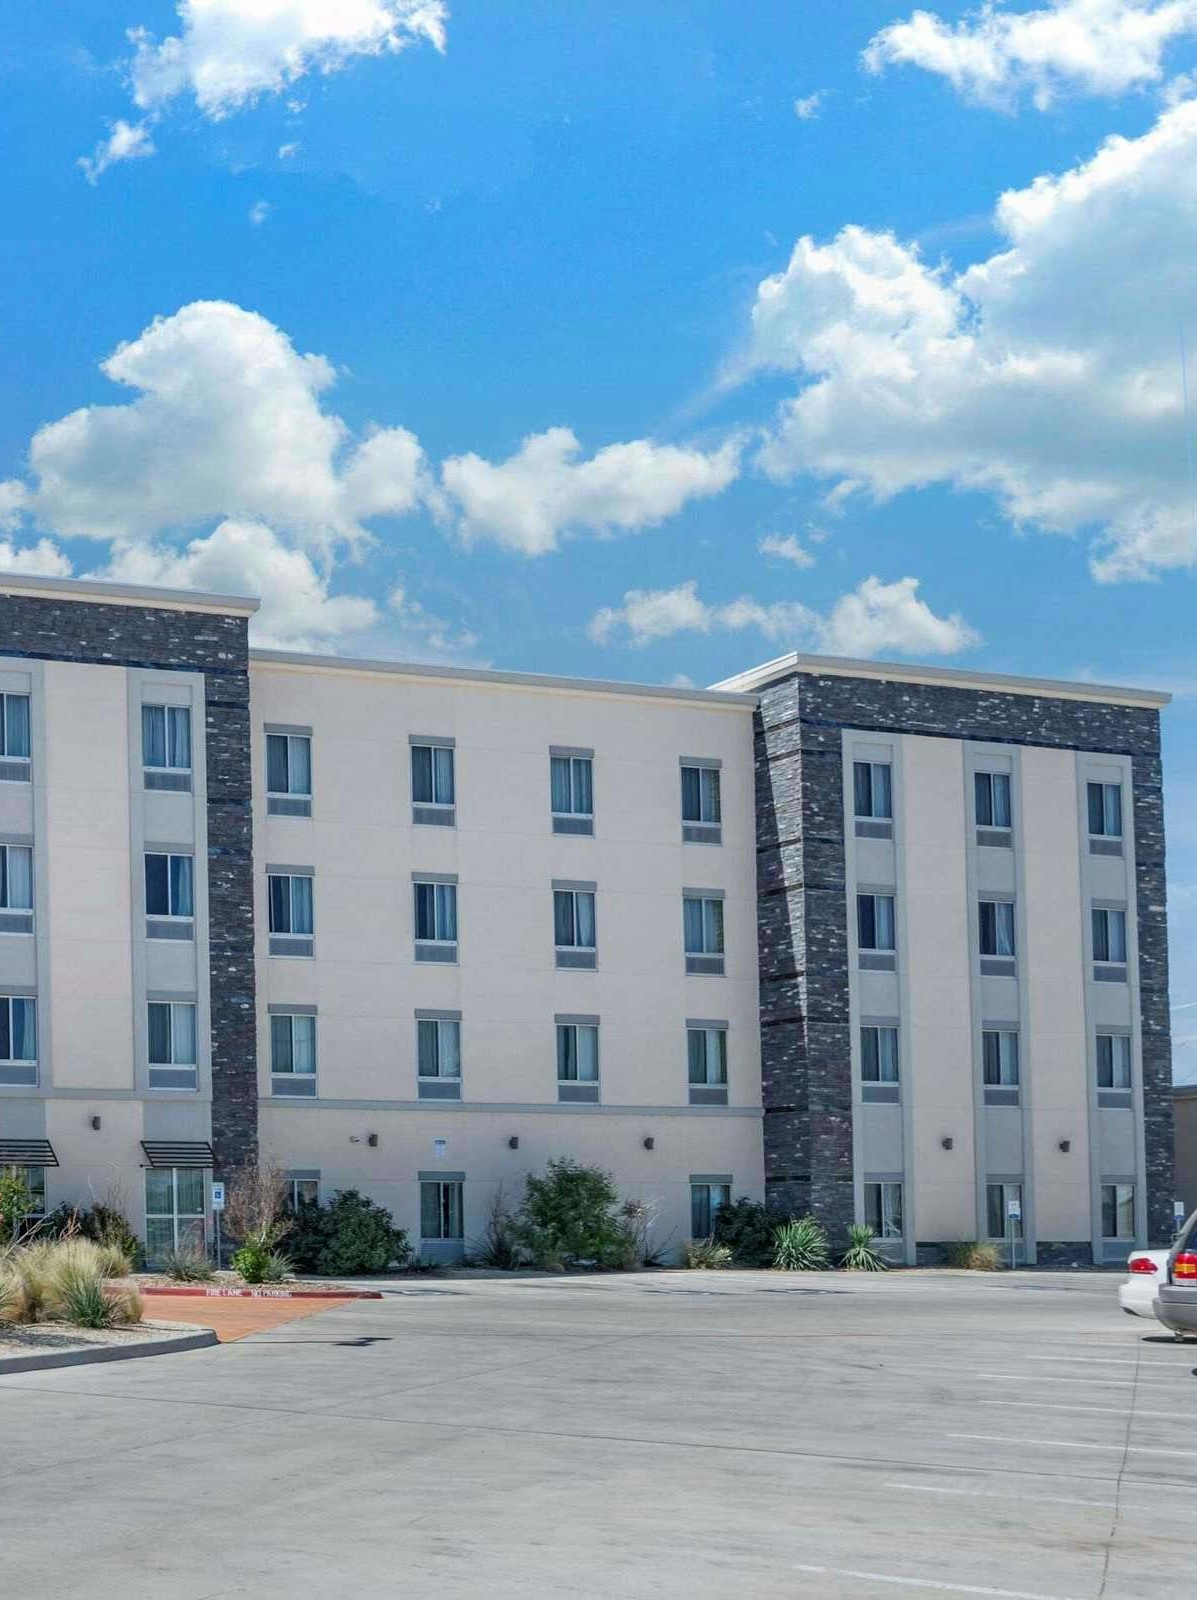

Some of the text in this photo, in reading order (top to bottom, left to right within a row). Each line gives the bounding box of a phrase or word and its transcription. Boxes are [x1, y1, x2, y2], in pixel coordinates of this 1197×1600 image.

[206, 1288, 293, 1298] FIRE LANE NO PARKING
